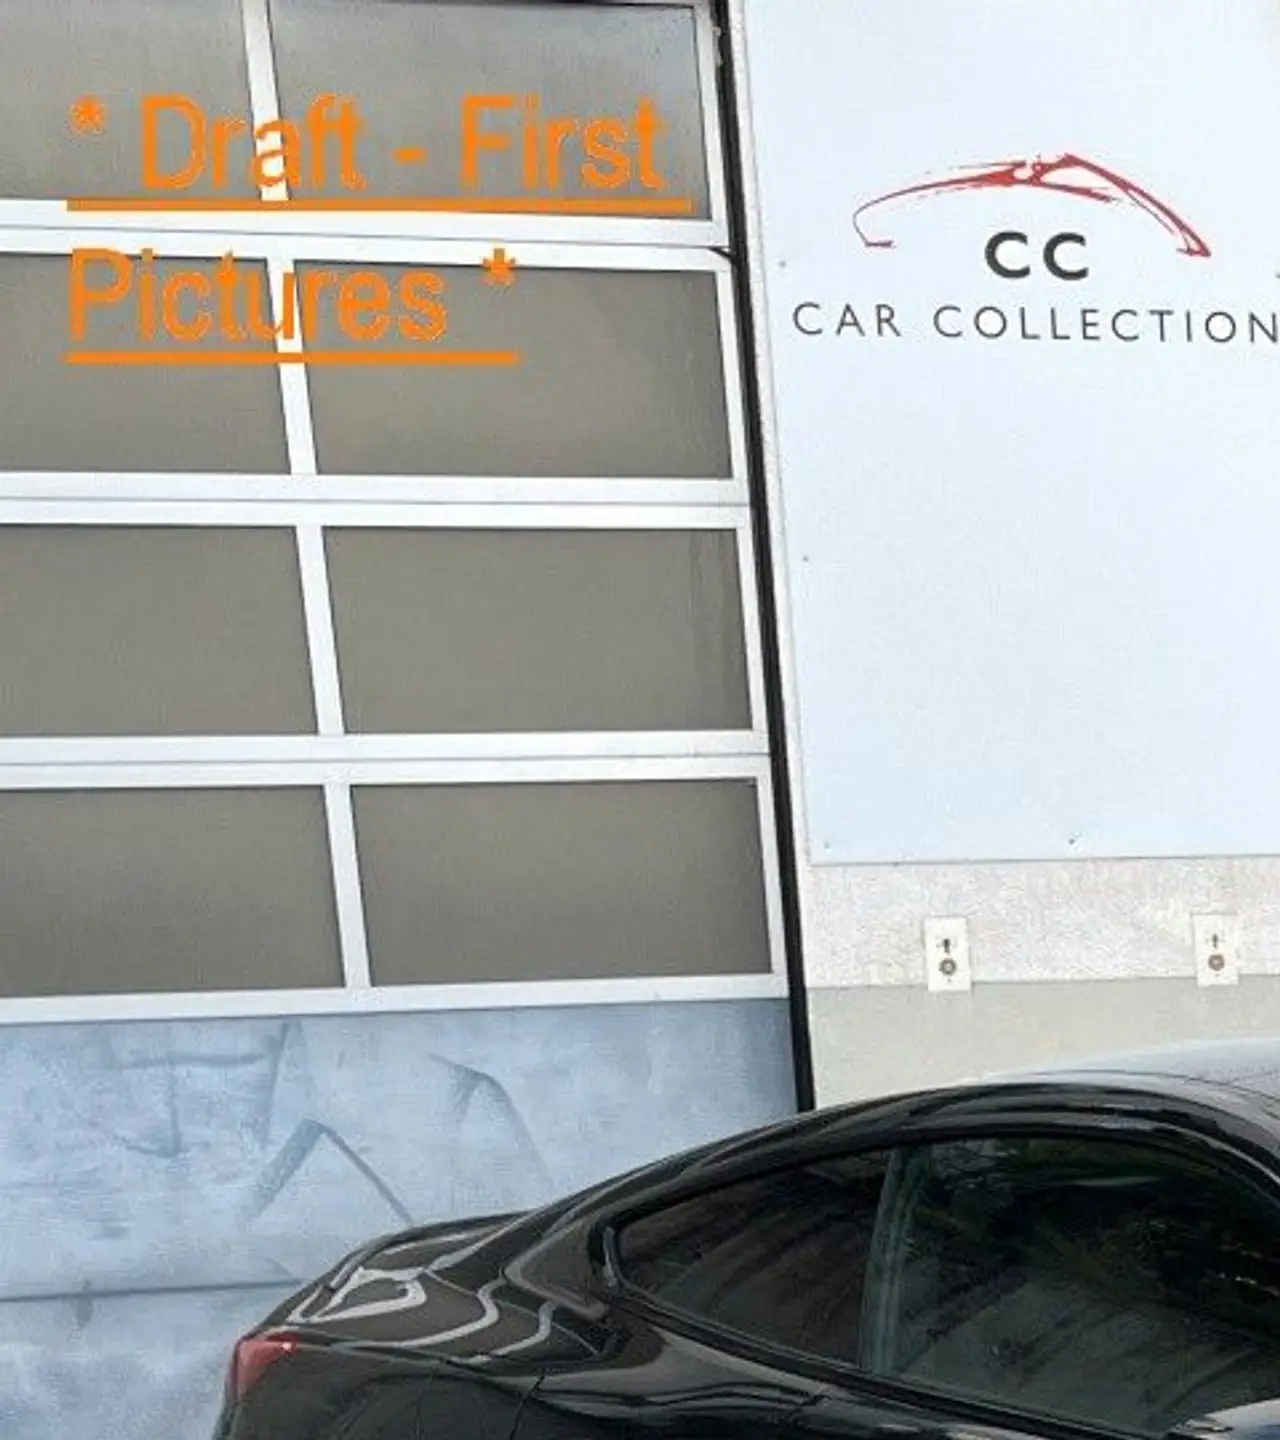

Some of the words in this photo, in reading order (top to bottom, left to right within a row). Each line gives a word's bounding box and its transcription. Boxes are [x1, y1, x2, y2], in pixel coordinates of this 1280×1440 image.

[983, 230, 1089, 282] CC
[792, 301, 902, 338] CAR
[932, 305, 1280, 344] COLLECTION
